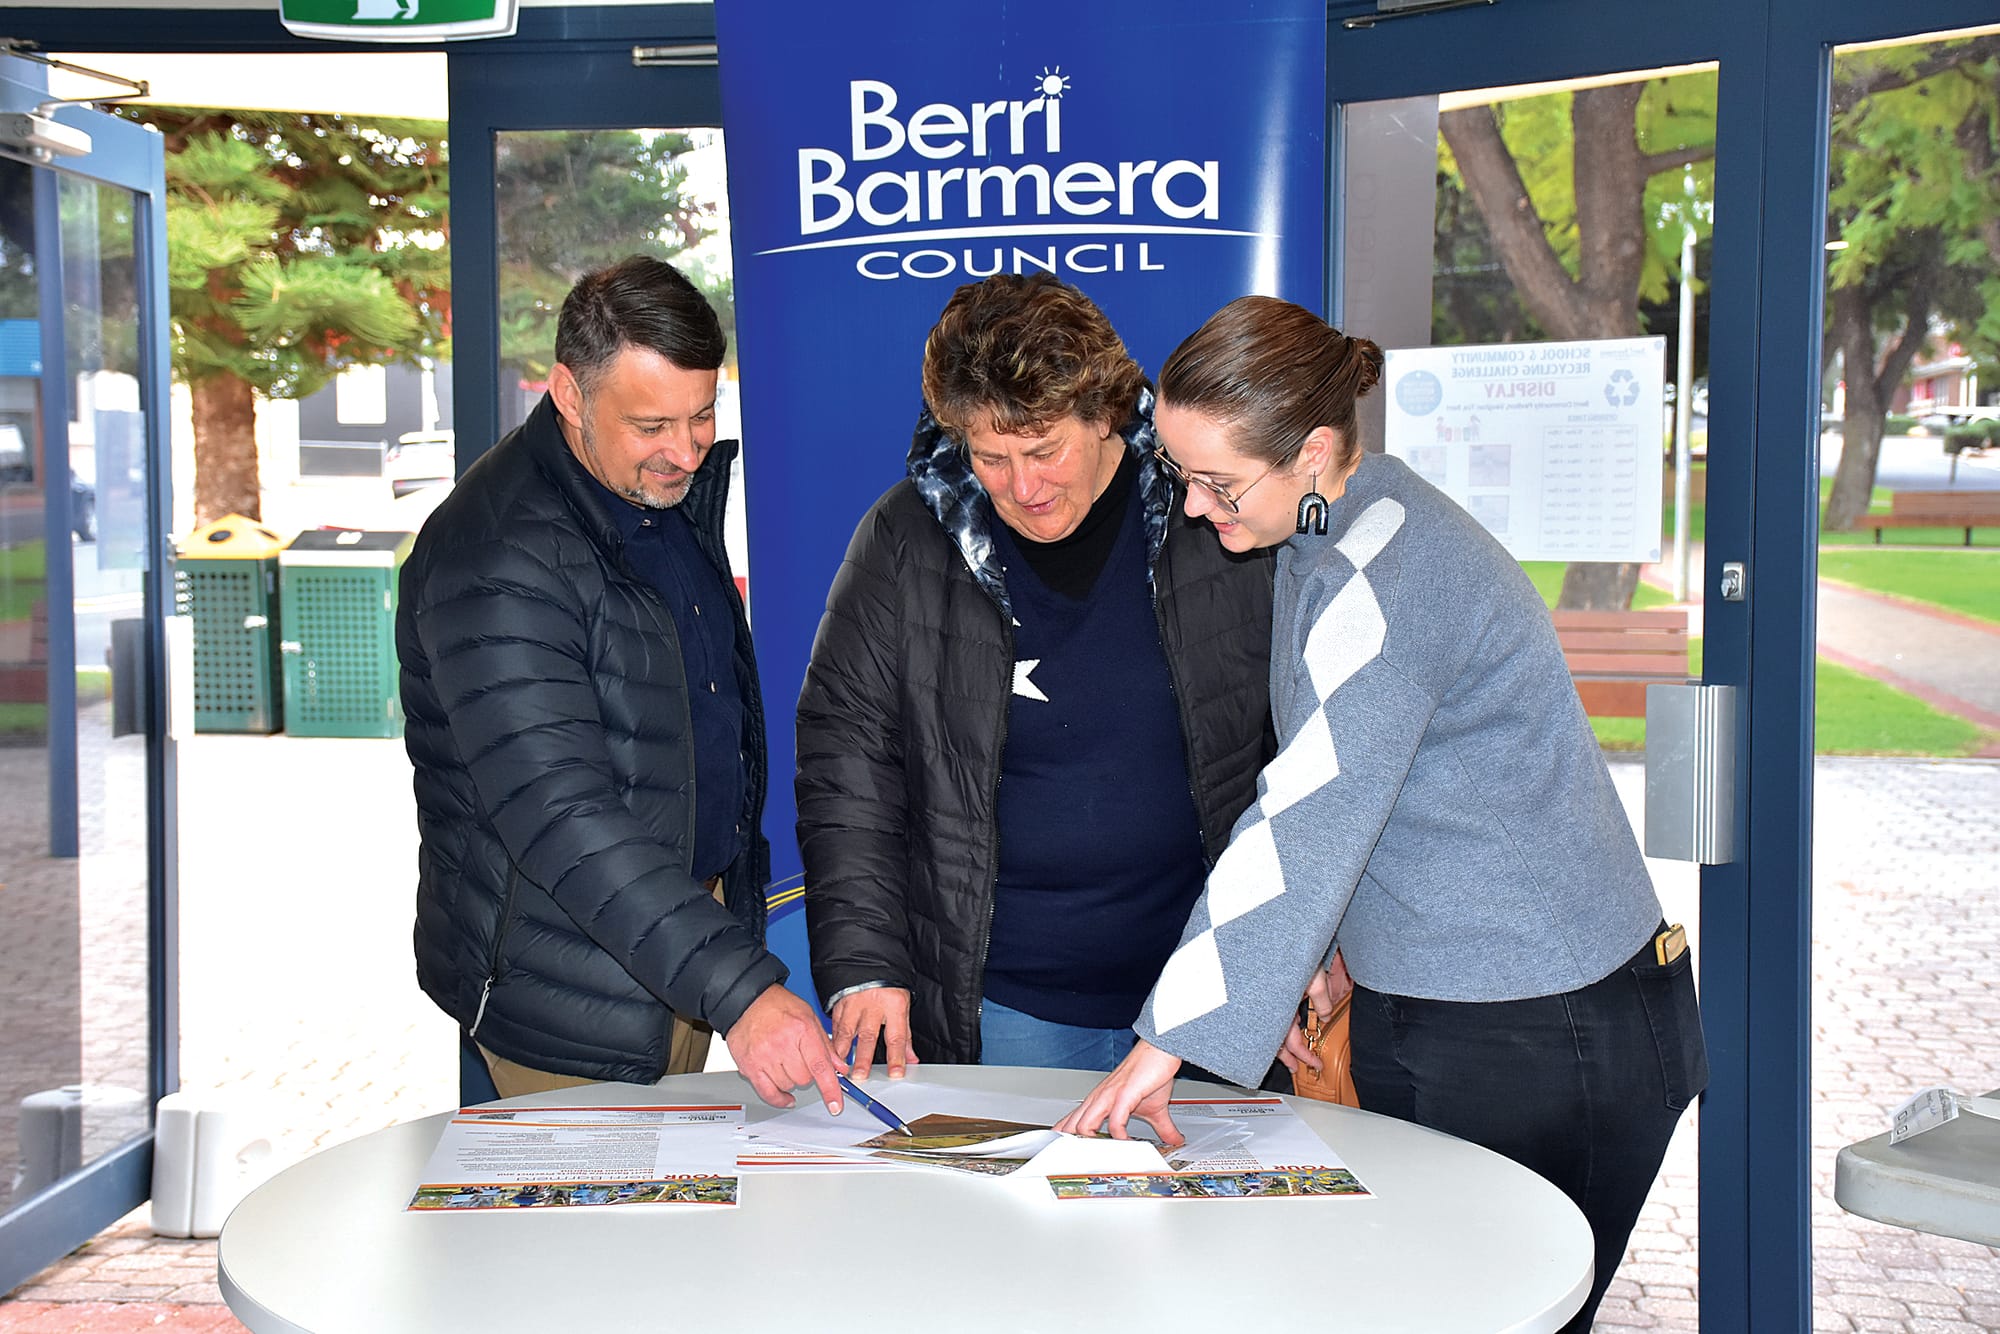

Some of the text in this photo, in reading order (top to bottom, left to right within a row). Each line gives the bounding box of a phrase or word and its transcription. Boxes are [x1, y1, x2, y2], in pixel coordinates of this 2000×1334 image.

[851, 70, 1066, 161] Berri
[799, 148, 1219, 236] Barmera
[856, 242, 1165, 280] COUNCIL
